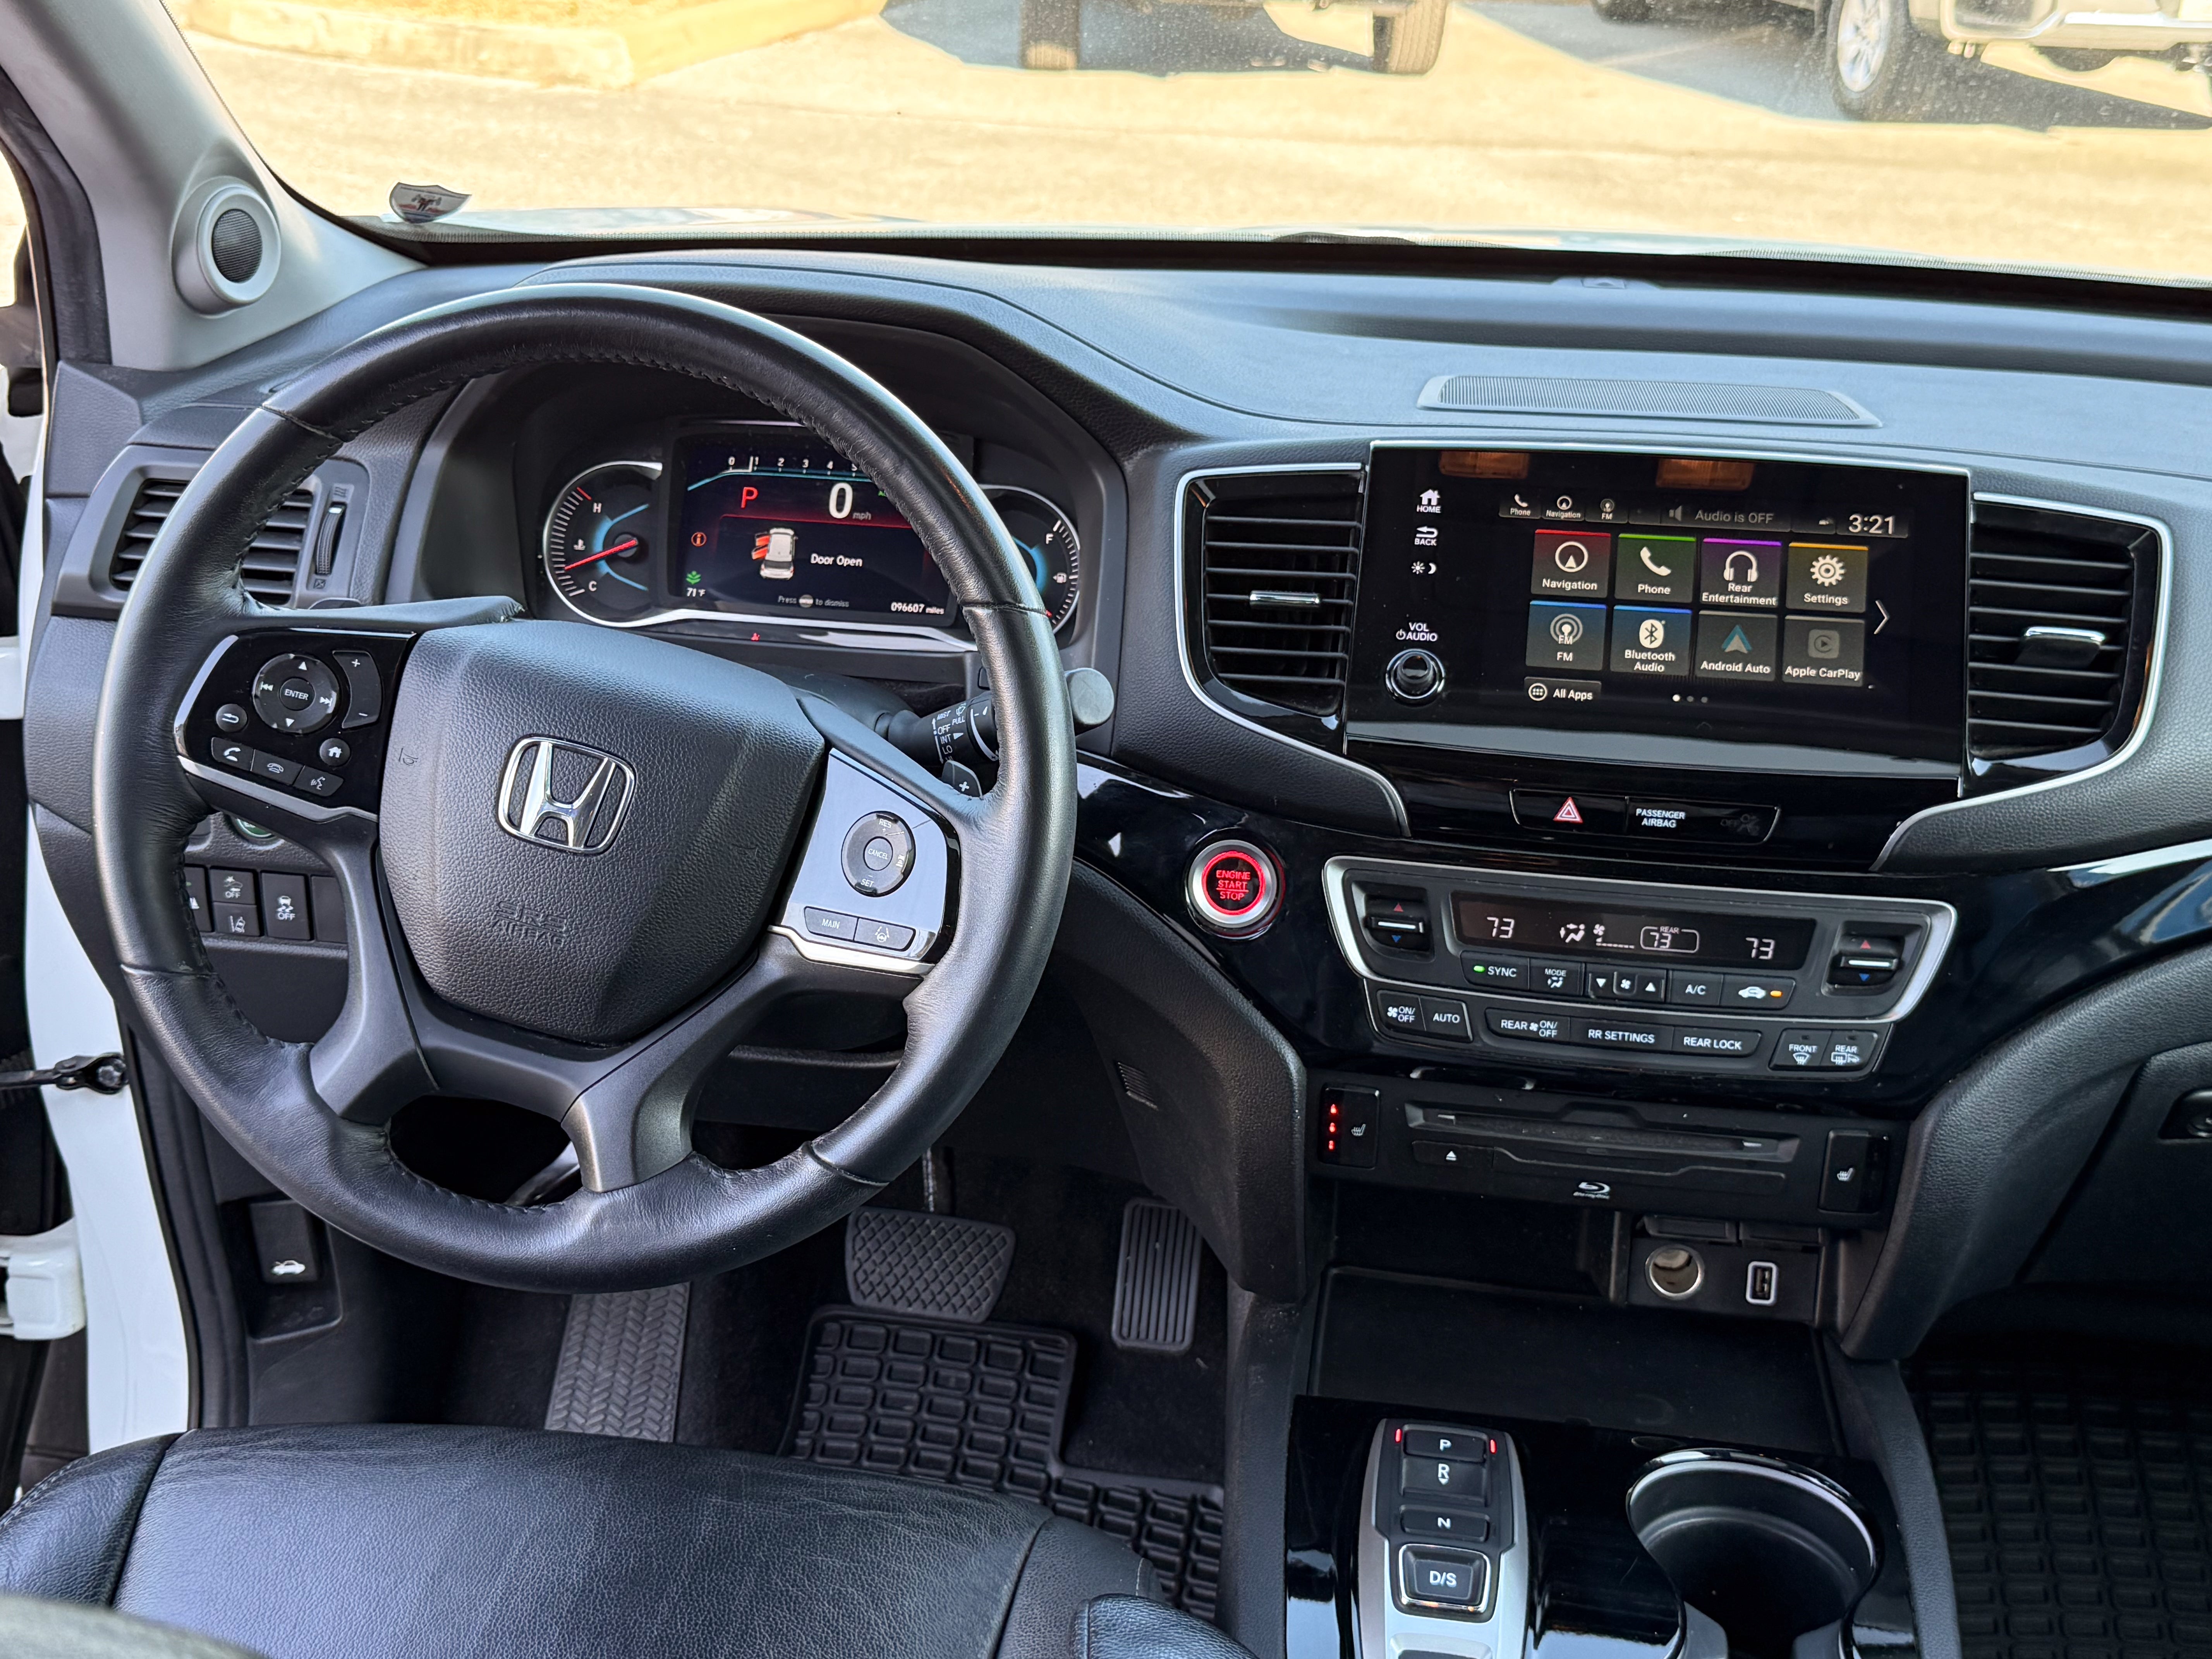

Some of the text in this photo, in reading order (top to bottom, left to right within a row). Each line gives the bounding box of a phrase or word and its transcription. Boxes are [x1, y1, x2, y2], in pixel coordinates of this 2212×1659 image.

[728, 457, 735, 465] 0
[755, 457, 759, 465] 1
[778, 457, 784, 467] 2
[802, 459, 809, 468] 3
[827, 461, 833, 469] 4
[741, 487, 758, 508] P
[829, 483, 871, 520] 0 mph
[593, 503, 601, 513] H
[1416, 505, 1441, 513] HOME
[1510, 508, 1531, 516] Phone
[1546, 510, 1581, 519] Navigation
[1695, 510, 1774, 524] Audio is OFF
[1848, 514, 1895, 535] 3:21
[1046, 533, 1053, 544] F
[811, 553, 863, 567] Door Open
[589, 581, 597, 591] C
[1542, 578, 1598, 591] Navigation
[1638, 584, 1671, 595] Phone
[1728, 583, 1753, 593] Rear
[778, 595, 797, 604] Press
[824, 599, 849, 607] dismiss
[1702, 592, 1778, 606] Entertainment
[1804, 593, 1848, 605] Settings
[891, 602, 945, 615] 096607 miles
[1409, 622, 1429, 632] VOL
[1406, 632, 1438, 642] AUDIO
[1558, 635, 1573, 644] FM
[1557, 652, 1573, 661] FM
[1625, 649, 1676, 661] Bluetooth
[1633, 661, 1665, 672] Audio
[1700, 660, 1771, 674] Android Auto
[1785, 666, 1861, 681] Apple CarPlay
[285, 689, 309, 700] ENTER
[1553, 688, 1593, 701] All Apps
[937, 710, 951, 720] MIST
[952, 716, 965, 725] PULL
[938, 724, 951, 735] OFF
[940, 734, 951, 744] INT
[942, 745, 953, 754] LO
[1636, 808, 1686, 819] PASSENGER
[879, 818, 891, 828] RES
[1641, 818, 1677, 828] AIRBAG
[868, 848, 888, 859] CANCEL
[1216, 870, 1250, 880] ENGINE
[860, 879, 874, 888] SET
[1218, 880, 1248, 890] START
[1220, 891, 1244, 900] STOP
[277, 912, 295, 921] OFF
[822, 919, 840, 929] MAIN
[1487, 917, 1515, 939] 73
[1660, 926, 1680, 934] REAR
[1650, 932, 1671, 948] 73
[1745, 937, 1776, 960] 73
[1487, 966, 1517, 977] SYNC
[1545, 968, 1566, 977] MODE
[1685, 984, 1706, 995] A/C
[1398, 1006, 1415, 1015] ON/
[1398, 1015, 1415, 1023] OFF
[1432, 1013, 1460, 1024] AUTO
[1501, 1019, 1558, 1030] REAR ON/
[1539, 1029, 1558, 1038] OFF
[1588, 1029, 1655, 1044] RR SETTINGS
[1683, 1036, 1742, 1051] REAR LOCK
[1788, 1044, 1818, 1053] FRONT
[1835, 1044, 1858, 1053] REAR
[1439, 1439, 1451, 1451] P
[1437, 1463, 1450, 1479] R
[1437, 1517, 1451, 1529] N
[1429, 1571, 1457, 1587] D/S
